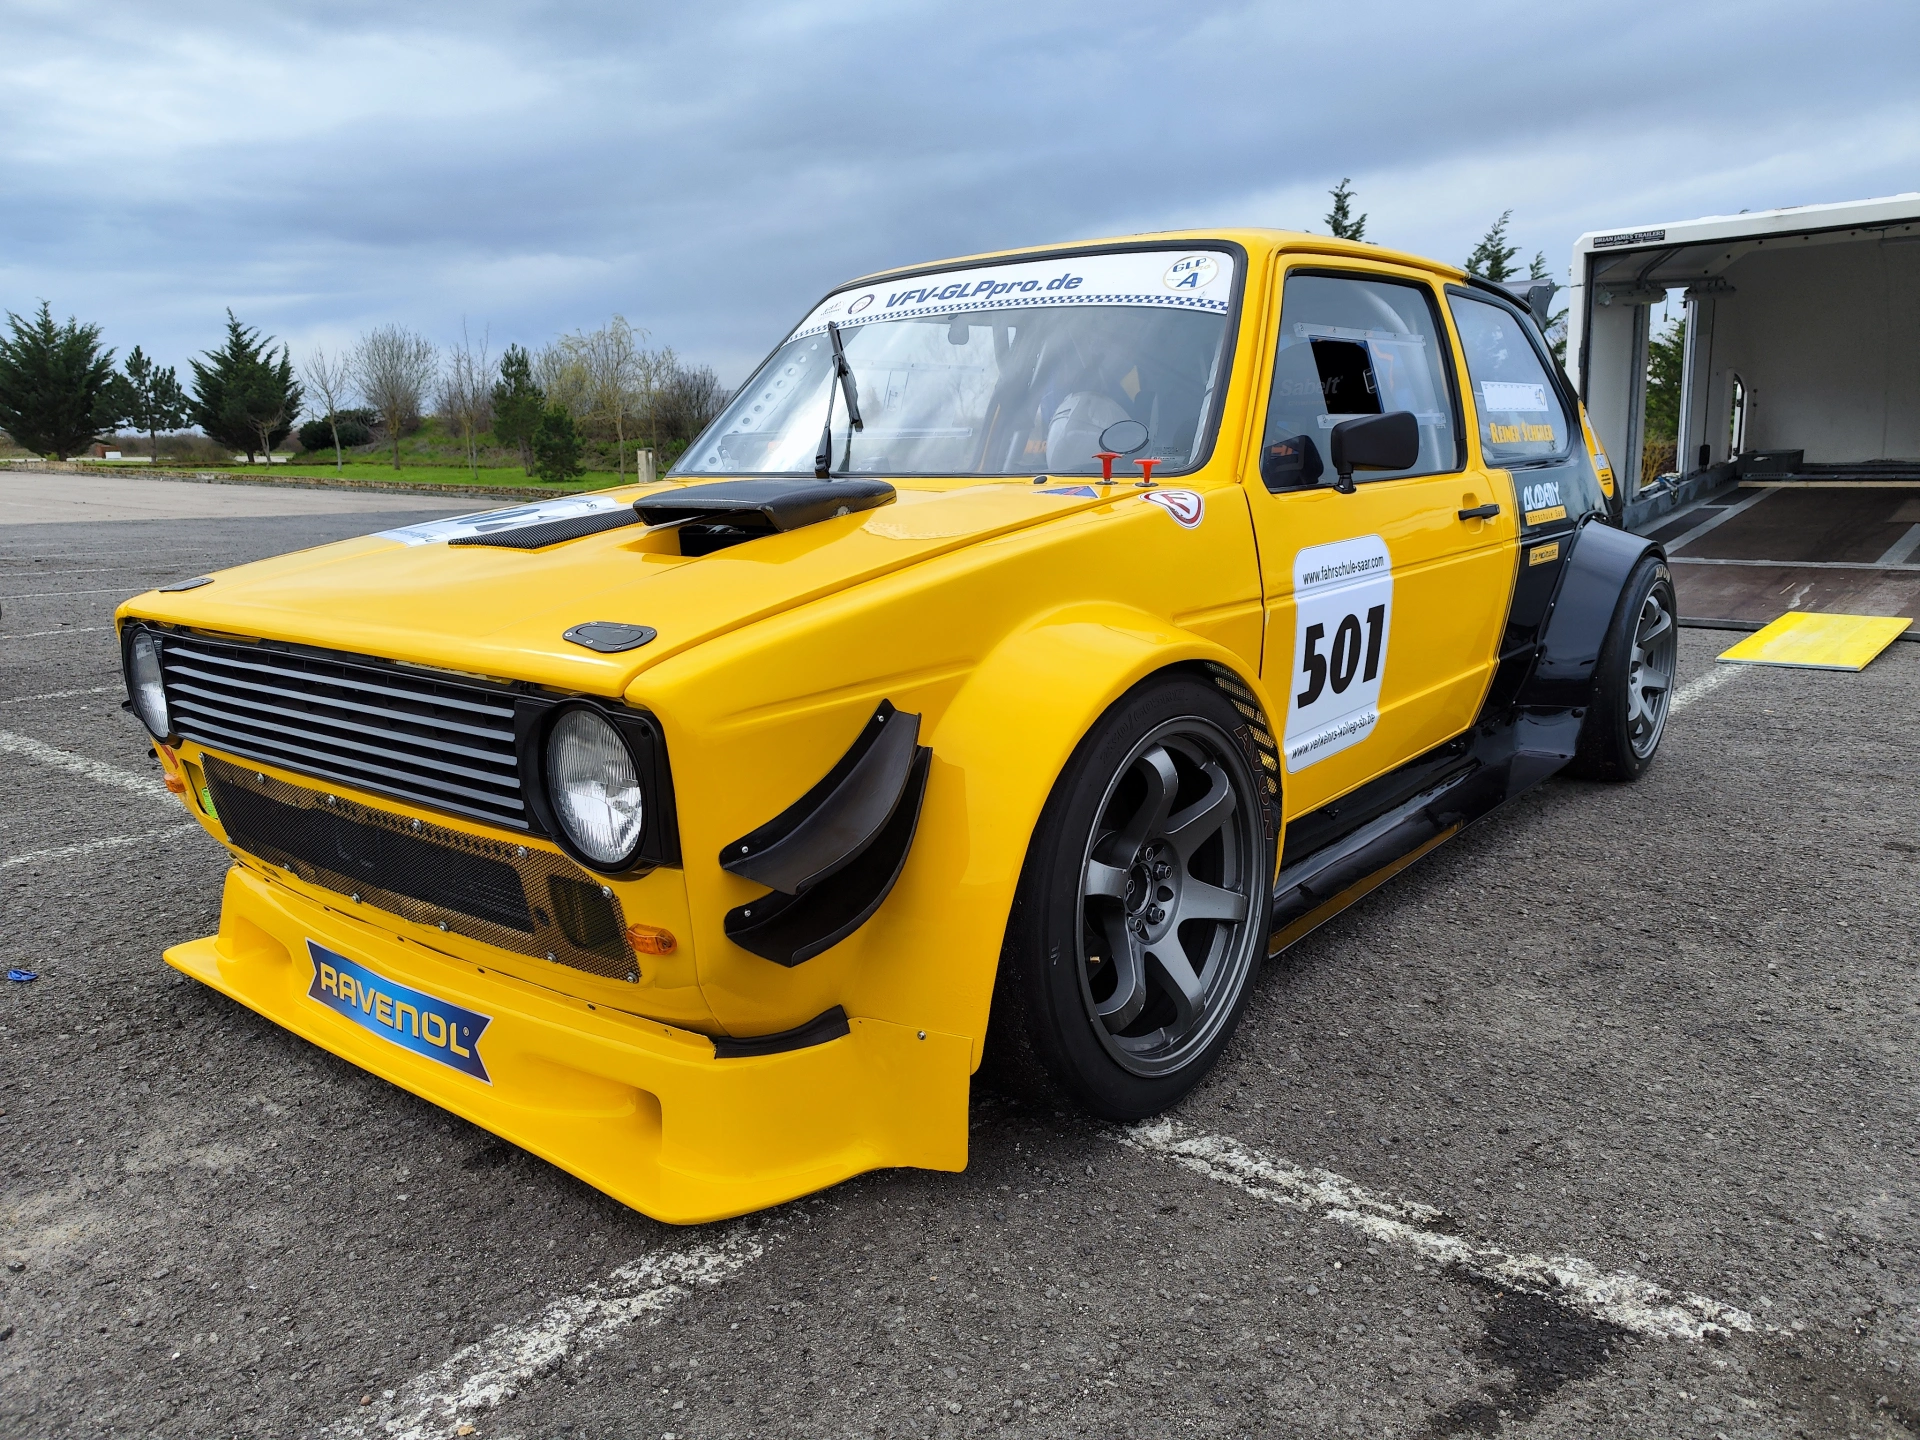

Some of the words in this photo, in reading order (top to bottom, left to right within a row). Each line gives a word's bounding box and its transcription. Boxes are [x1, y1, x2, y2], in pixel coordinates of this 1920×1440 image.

[1172, 257, 1207, 272] GLP
[1175, 272, 1198, 288] A
[886, 273, 1083, 308] VFV-GLPpro.de
[1279, 377, 1341, 397] Sabelt
[1303, 556, 1384, 585] www.fahrschule-saar.com
[1297, 604, 1385, 709] 501
[1233, 724, 1274, 840] AVON
[320, 962, 470, 1059] RAVENOL
